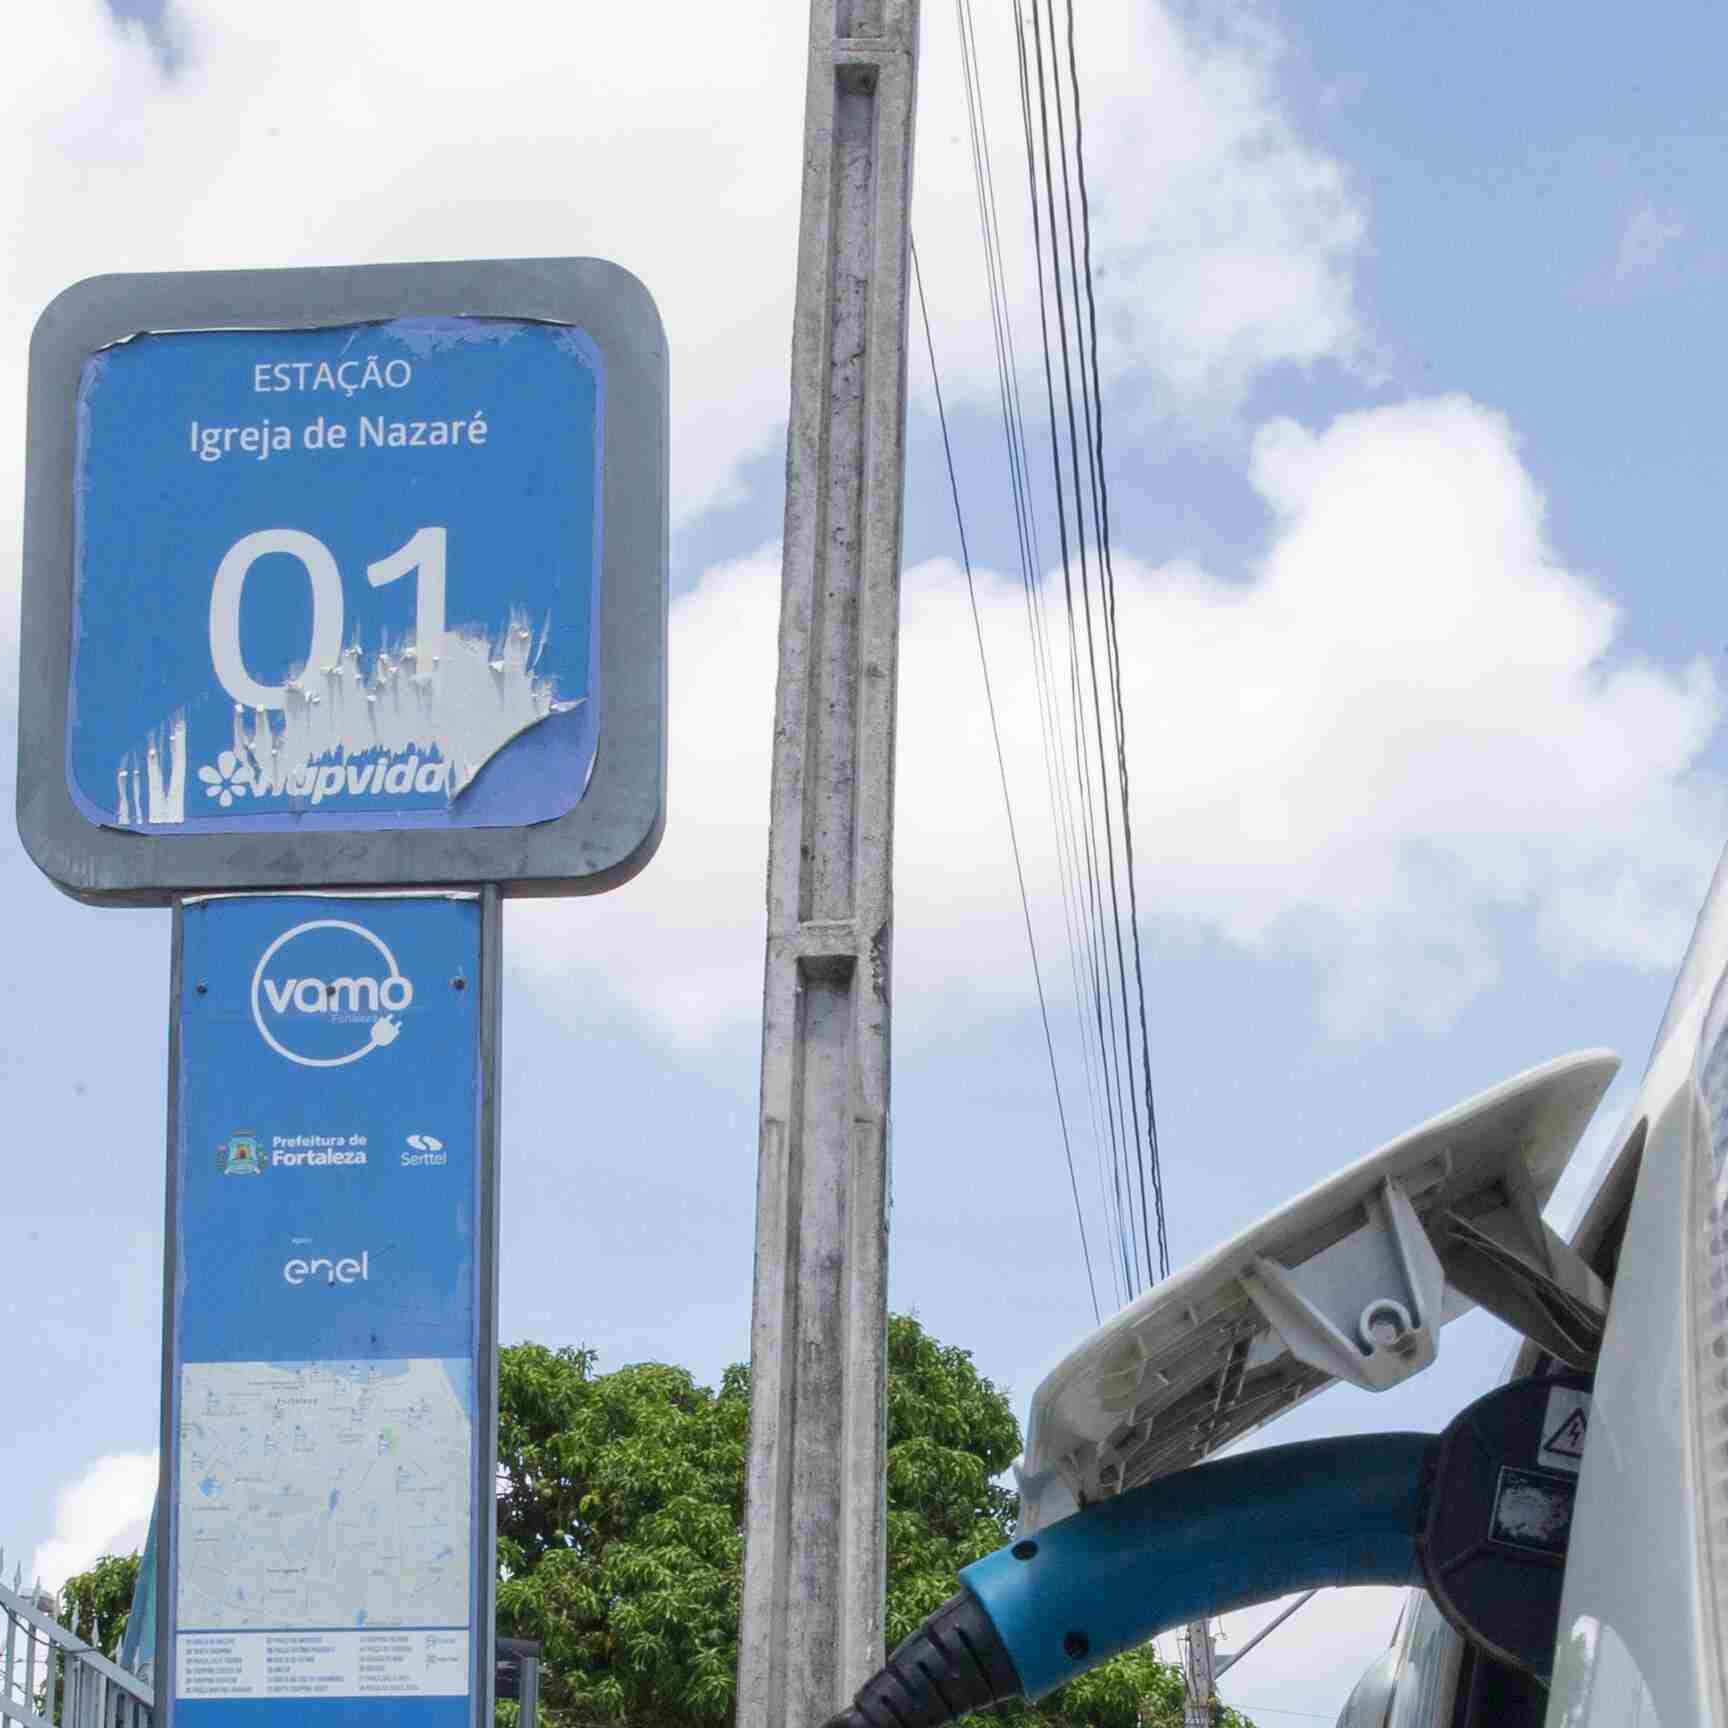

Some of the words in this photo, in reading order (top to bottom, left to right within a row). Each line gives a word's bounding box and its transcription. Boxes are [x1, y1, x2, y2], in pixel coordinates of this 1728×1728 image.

[253, 357, 412, 398] ESTAÇÃO
[189, 419, 292, 461] Igreja
[303, 416, 346, 449] de
[358, 410, 488, 448] Nazaré
[208, 526, 447, 711] 01
[263, 975, 414, 1014] vamo
[272, 1135, 345, 1148] Prefeitura
[349, 1133, 368, 1146] de
[272, 1149, 368, 1166] Fortaleza
[400, 1151, 448, 1166] Serttel
[284, 1250, 369, 1285] enel
